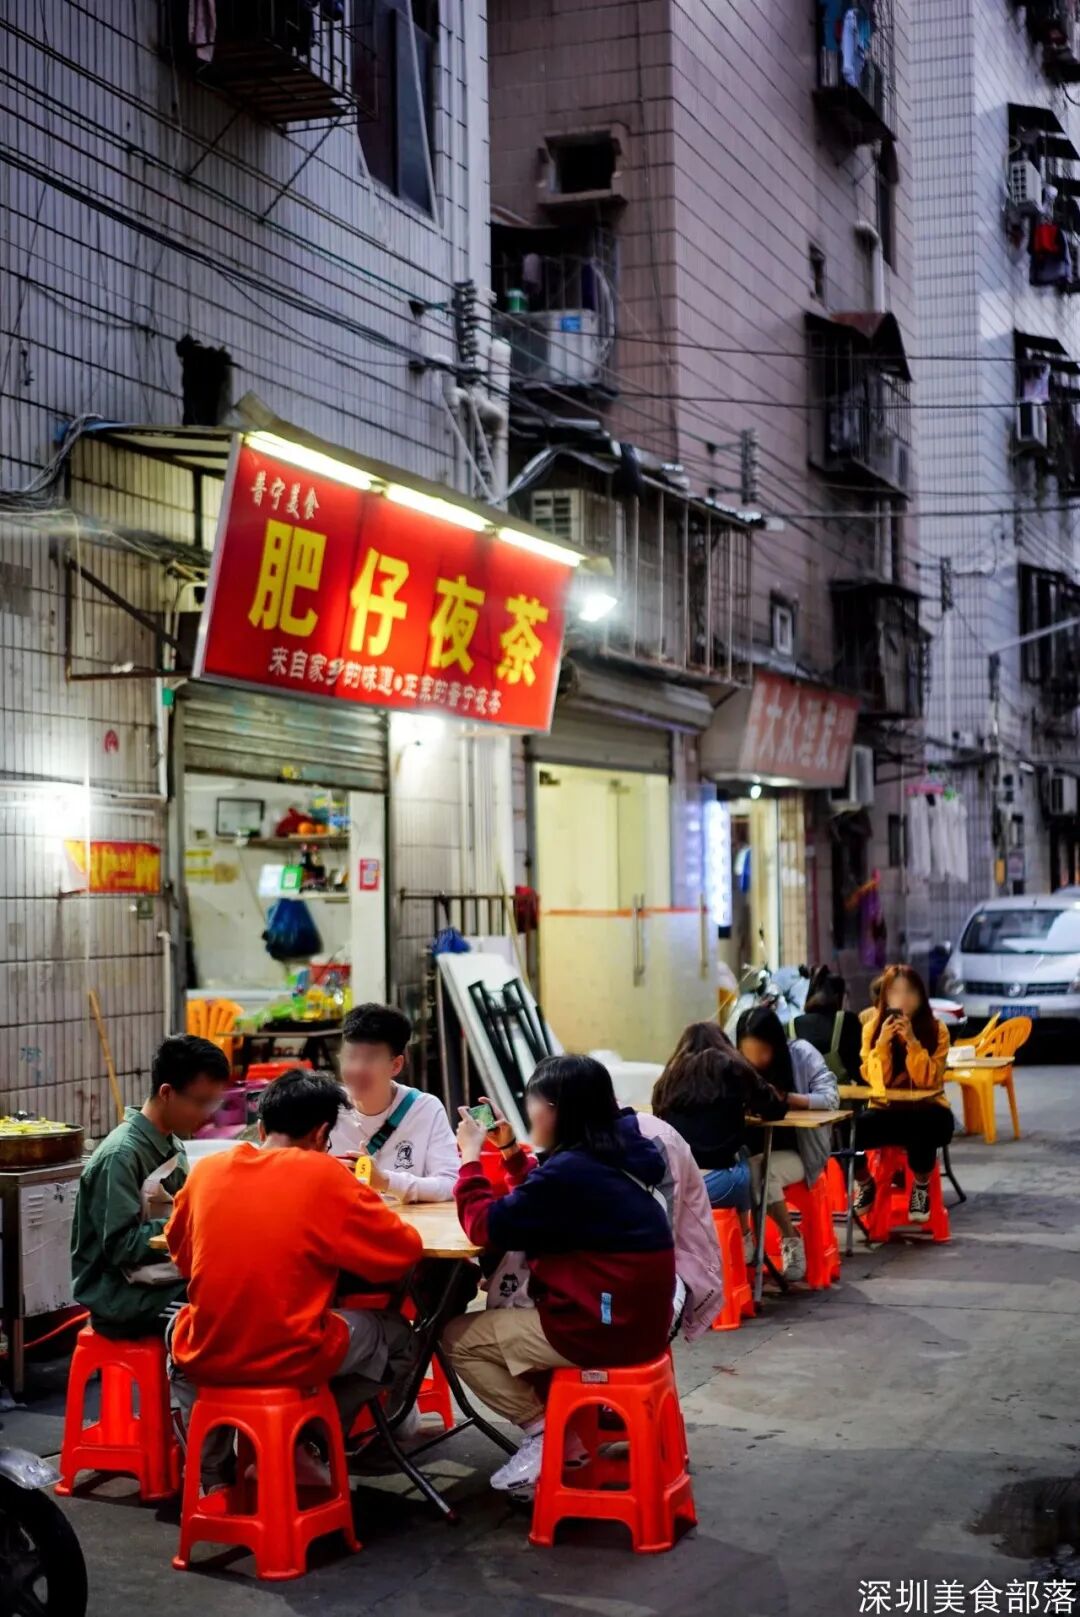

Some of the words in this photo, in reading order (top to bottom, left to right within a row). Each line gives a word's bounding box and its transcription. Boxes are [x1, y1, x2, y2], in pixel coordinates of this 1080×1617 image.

[250, 470, 321, 521] 普宁美食
[248, 518, 550, 687] 肥仔夜茶
